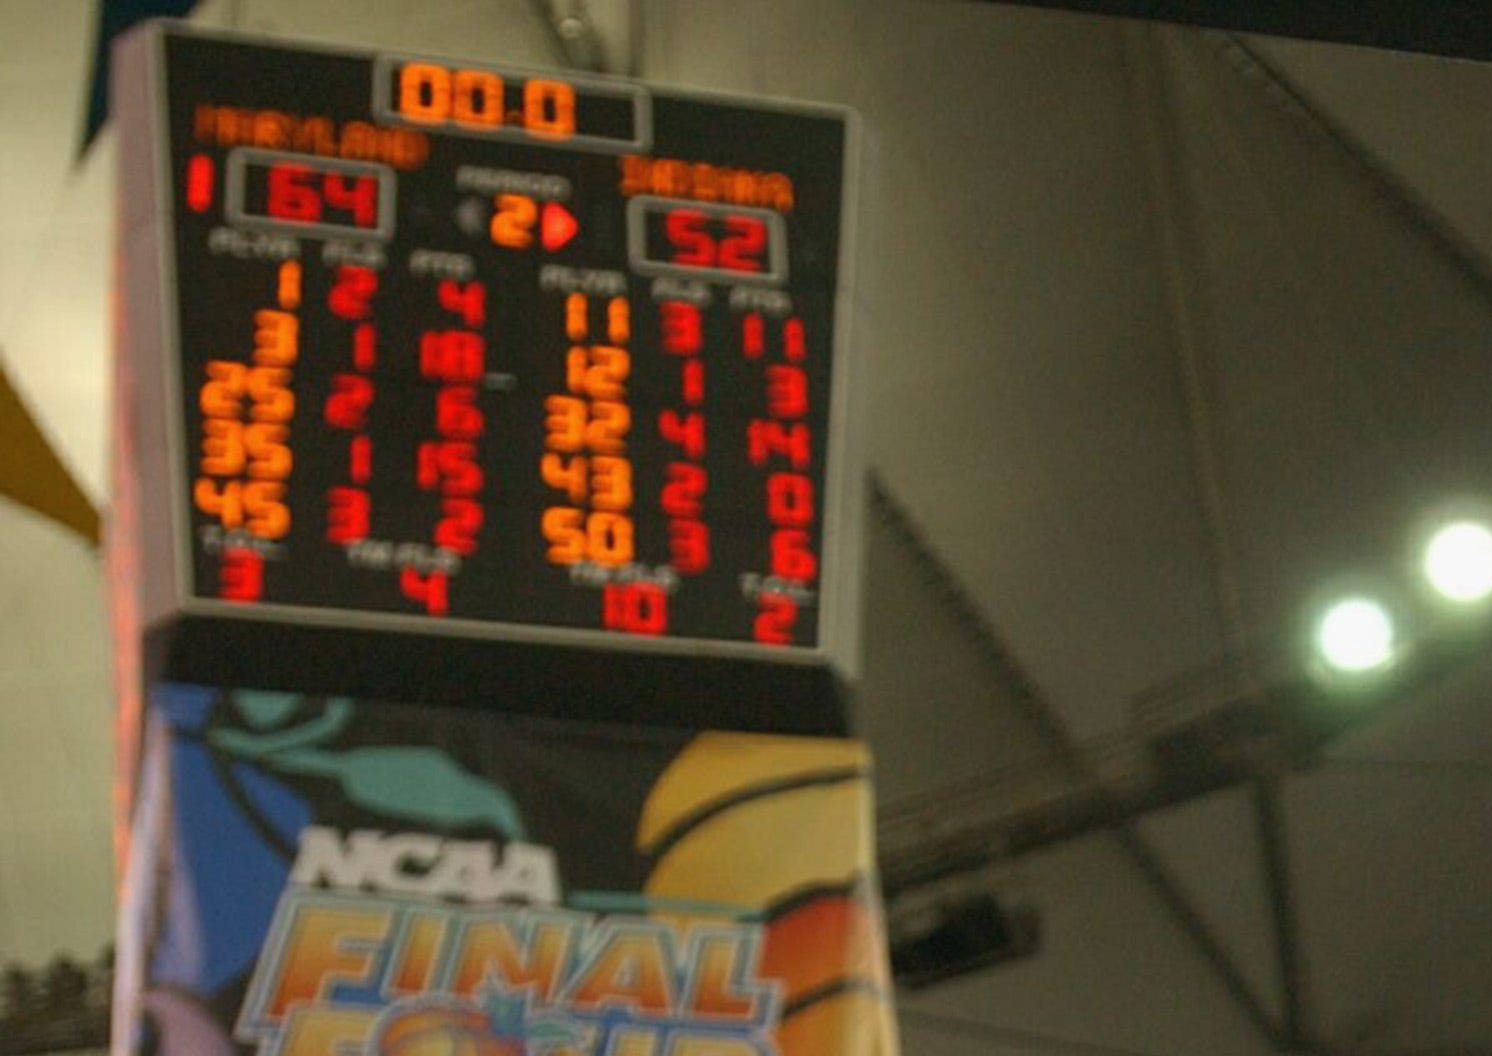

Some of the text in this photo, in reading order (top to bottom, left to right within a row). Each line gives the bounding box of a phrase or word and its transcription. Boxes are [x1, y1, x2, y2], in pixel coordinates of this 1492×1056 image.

[401, 62, 576, 140] 00.0
[267, 161, 379, 229] 64
[490, 193, 537, 248] 2
[666, 207, 767, 273] 52
[278, 258, 486, 326] 1 2 4
[254, 308, 299, 367] 3
[353, 322, 376, 372] 1
[567, 292, 805, 361] 11 3 11
[199, 360, 484, 440] 25 2 6
[566, 346, 809, 418] 12 1 3
[199, 418, 483, 495] 35 1 15
[545, 395, 631, 450] 32
[657, 409, 706, 458] 4
[194, 479, 484, 555] 45 3 2
[541, 452, 814, 525] 43 2 0
[220, 546, 264, 604] 3
[541, 505, 817, 585] 50 3 6
[400, 565, 448, 616] 4
[603, 579, 667, 639] 10
[753, 590, 797, 645] 2
[291, 827, 562, 904] NCAA
[248, 902, 780, 1030] FINAL
